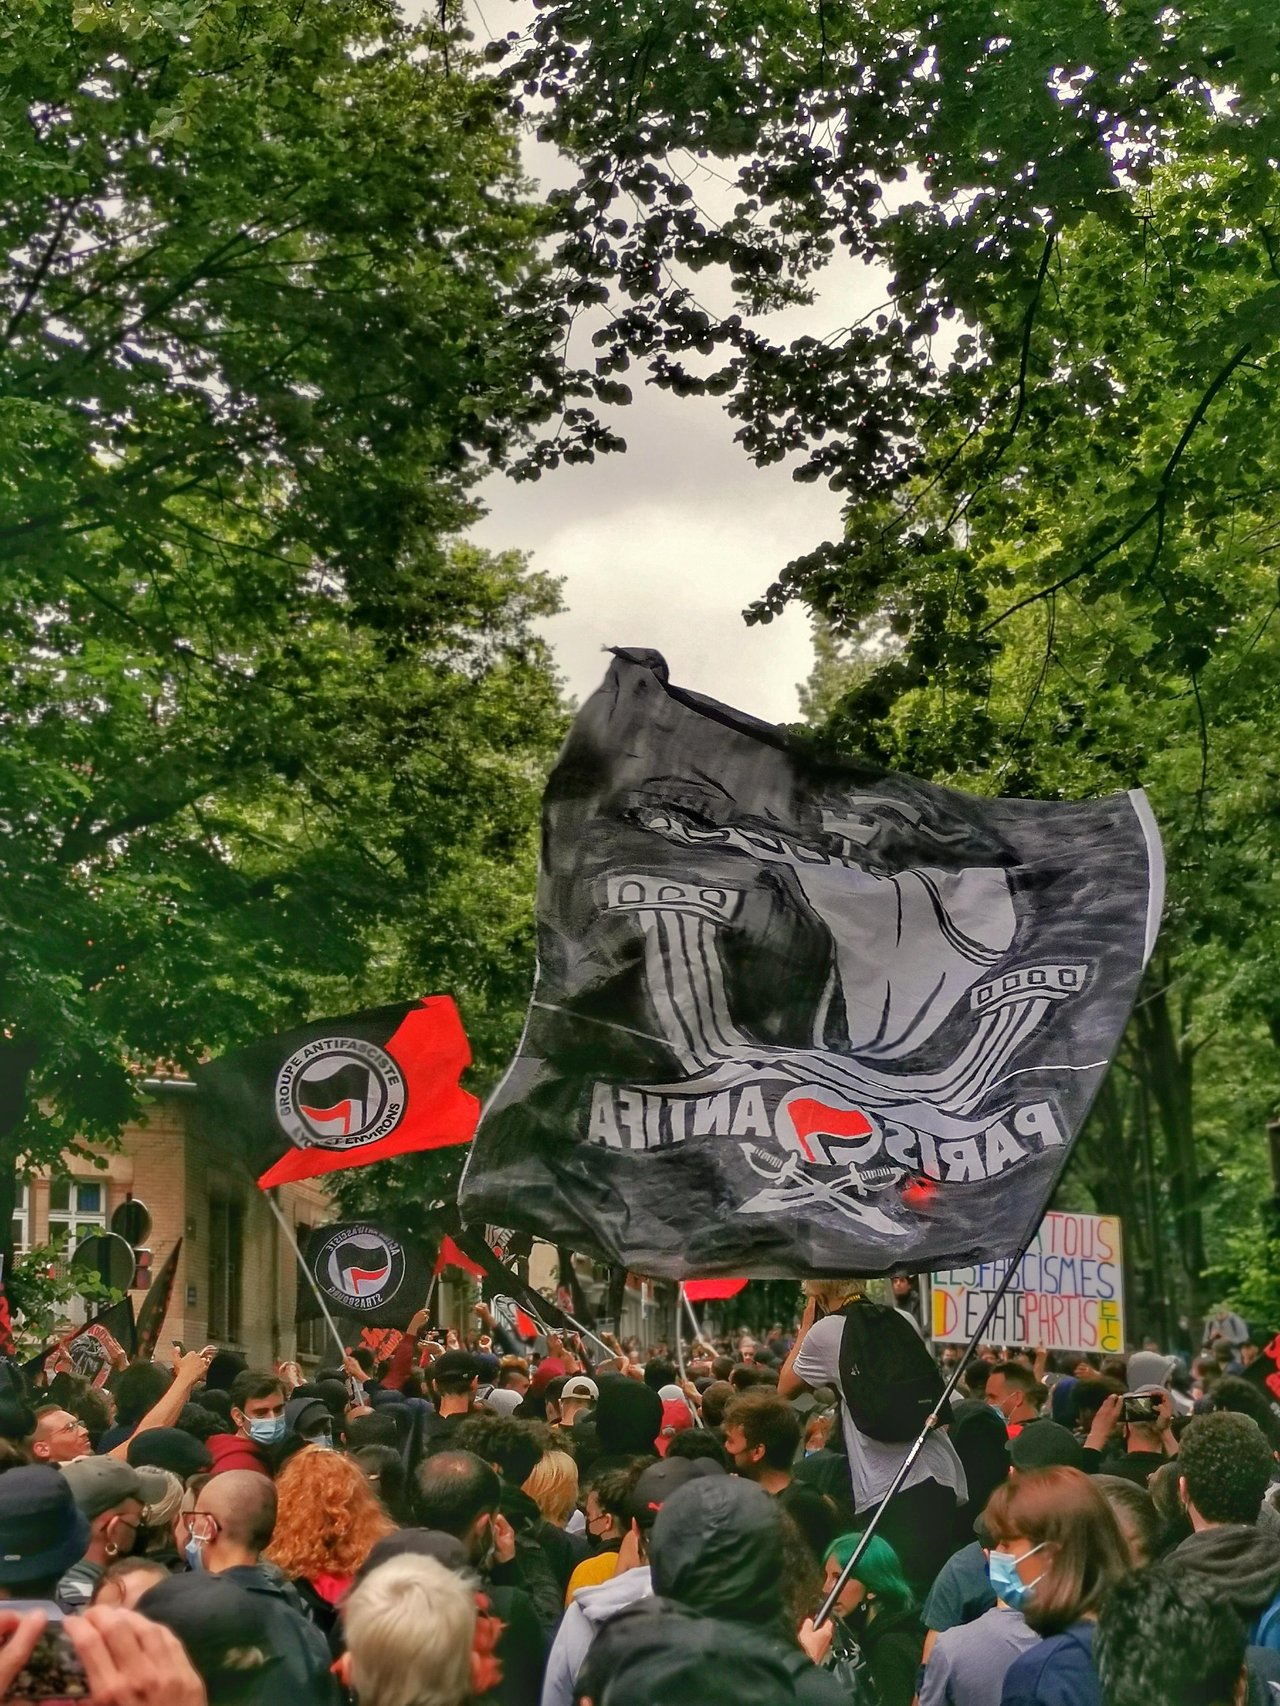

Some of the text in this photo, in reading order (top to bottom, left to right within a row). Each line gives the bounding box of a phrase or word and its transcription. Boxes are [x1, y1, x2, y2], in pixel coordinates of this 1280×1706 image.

[279, 1039, 400, 1116] GROUPE ANTIFASCISTE
[345, 1102, 400, 1145] ENVIRONS
[1046, 1213, 1114, 1260] TOUS
[1024, 1292, 1098, 1347] PARTIS
[1100, 1300, 1119, 1352] ETC
